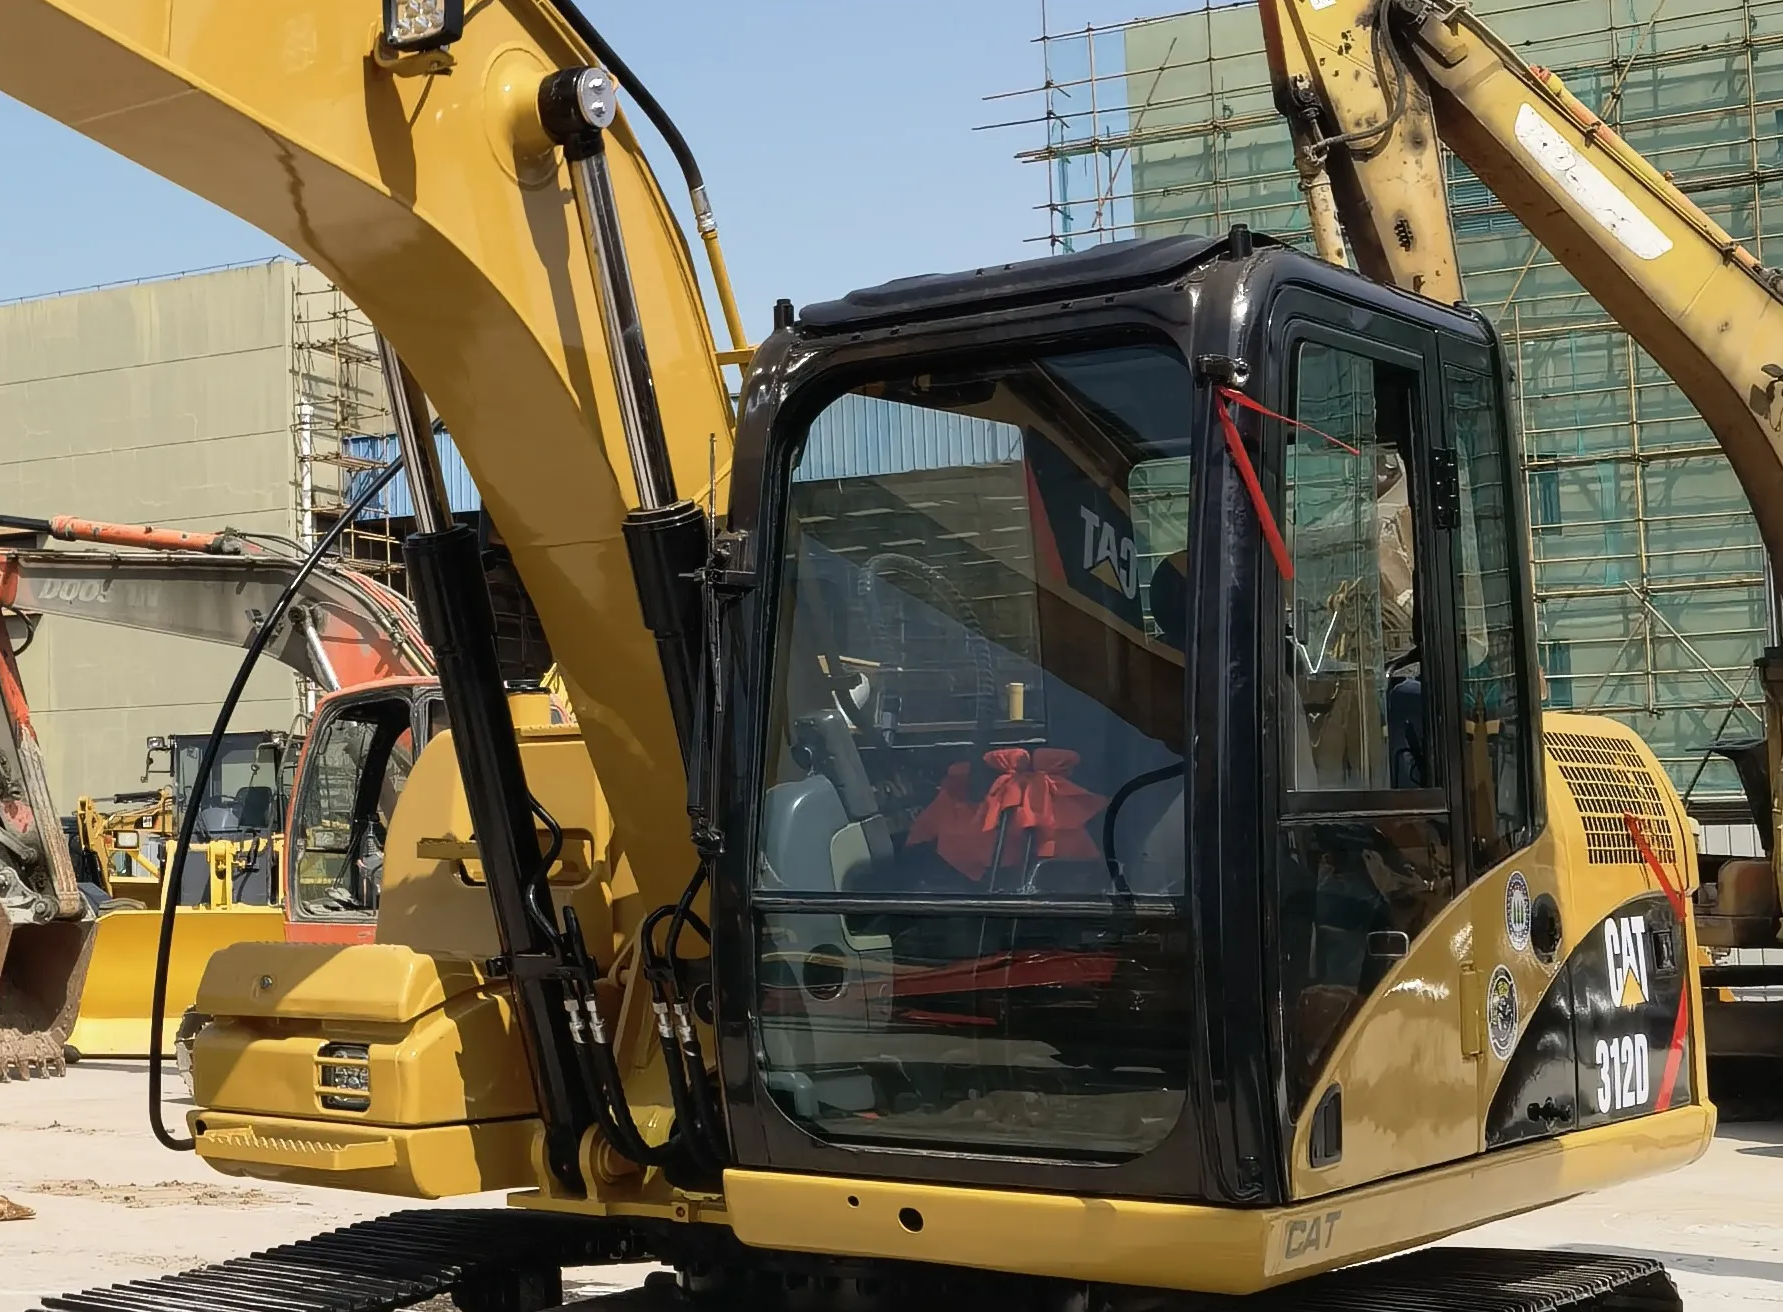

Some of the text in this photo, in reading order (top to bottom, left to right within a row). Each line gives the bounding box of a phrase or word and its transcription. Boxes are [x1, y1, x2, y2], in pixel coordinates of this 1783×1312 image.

[1604, 916, 1649, 1007] CAT
[1595, 1033, 1649, 1114] 312D
[1285, 1211, 1342, 1259] CAT
